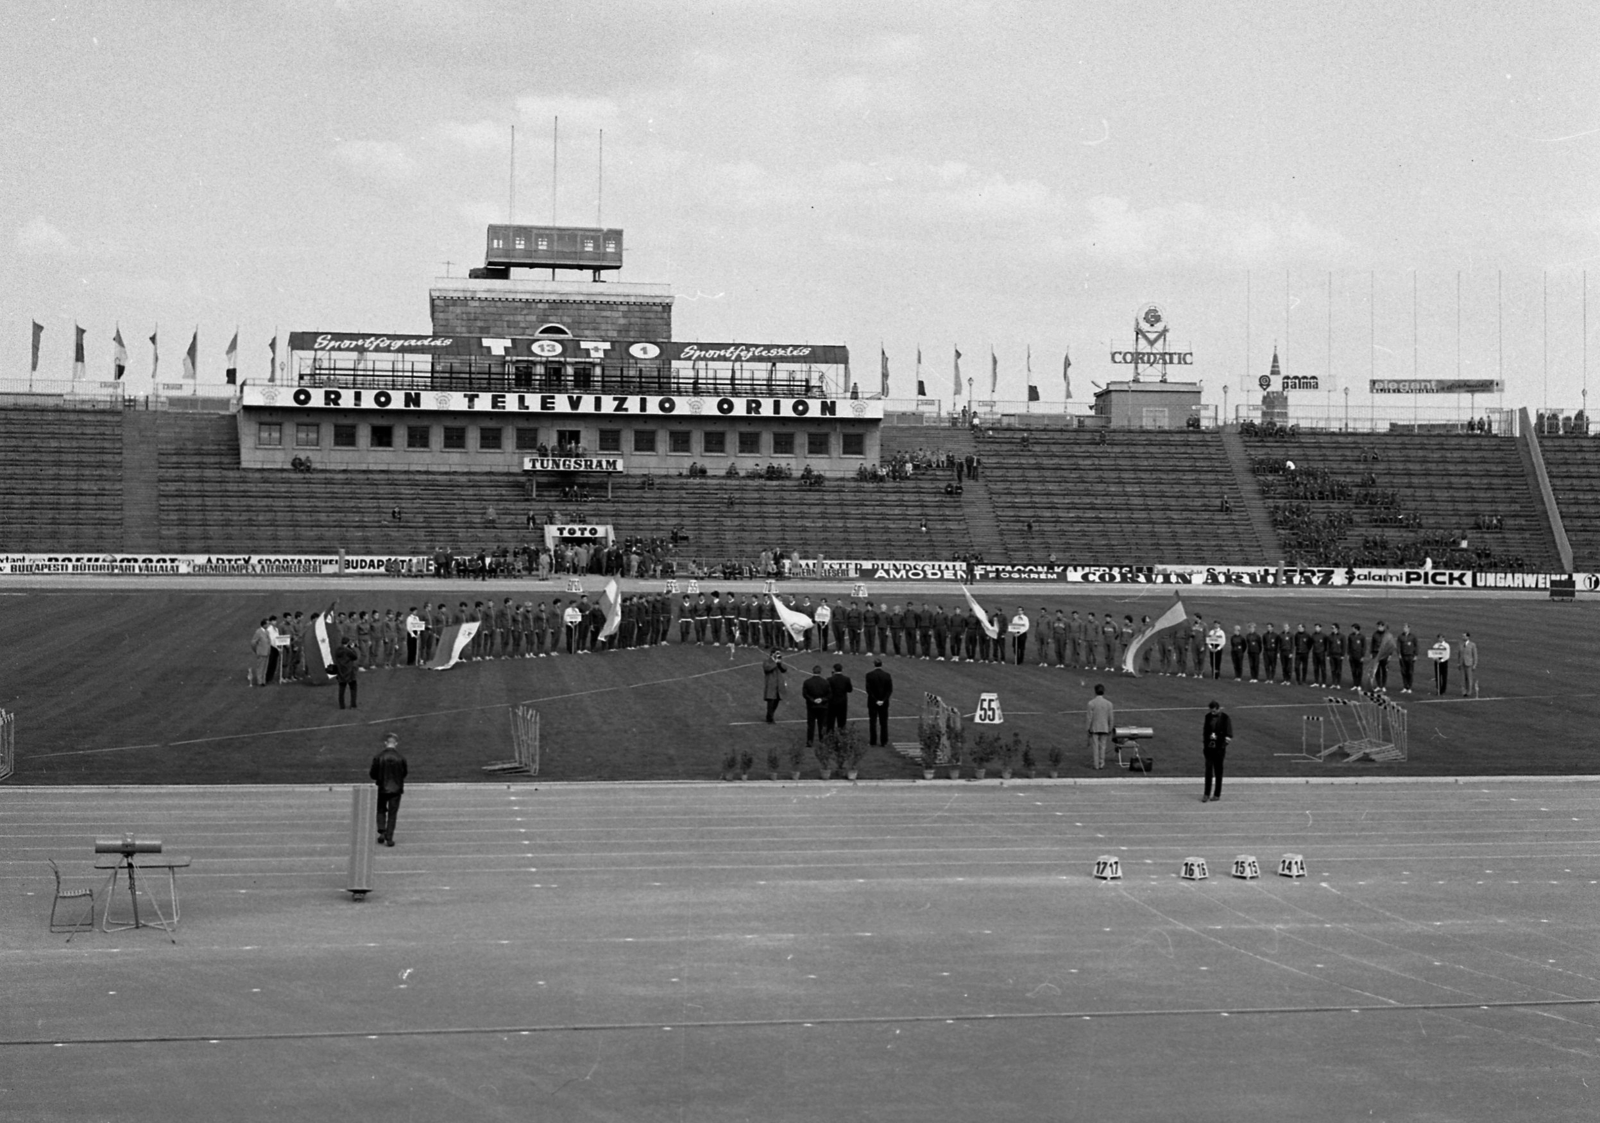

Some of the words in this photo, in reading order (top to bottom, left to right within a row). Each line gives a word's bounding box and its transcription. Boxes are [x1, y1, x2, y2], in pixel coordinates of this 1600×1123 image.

[314, 334, 453, 350] Sportfogadás
[537, 343, 553, 354] 13
[680, 344, 812, 361] Sportfejlesztés
[1110, 352, 1193, 366] CORDATIC
[1283, 377, 1319, 392] palma
[292, 388, 421, 409] ORION
[463, 393, 676, 414] TELEVIZIO
[716, 396, 837, 417] ORION
[529, 458, 618, 471] TUNGSRAM
[557, 527, 598, 536] TOTO
[874, 569, 984, 580] AMODENT
[1080, 571, 1193, 584] CORVIN
[1405, 571, 1467, 586] PICK
[979, 698, 996, 722] 55
[1095, 861, 1108, 875] 17
[1109, 861, 1120, 876] 17
[1183, 862, 1195, 877] 16
[1234, 860, 1246, 875] 15
[1248, 861, 1259, 876] 15
[1281, 859, 1293, 874] 14
[1294, 859, 1305, 874] 14
